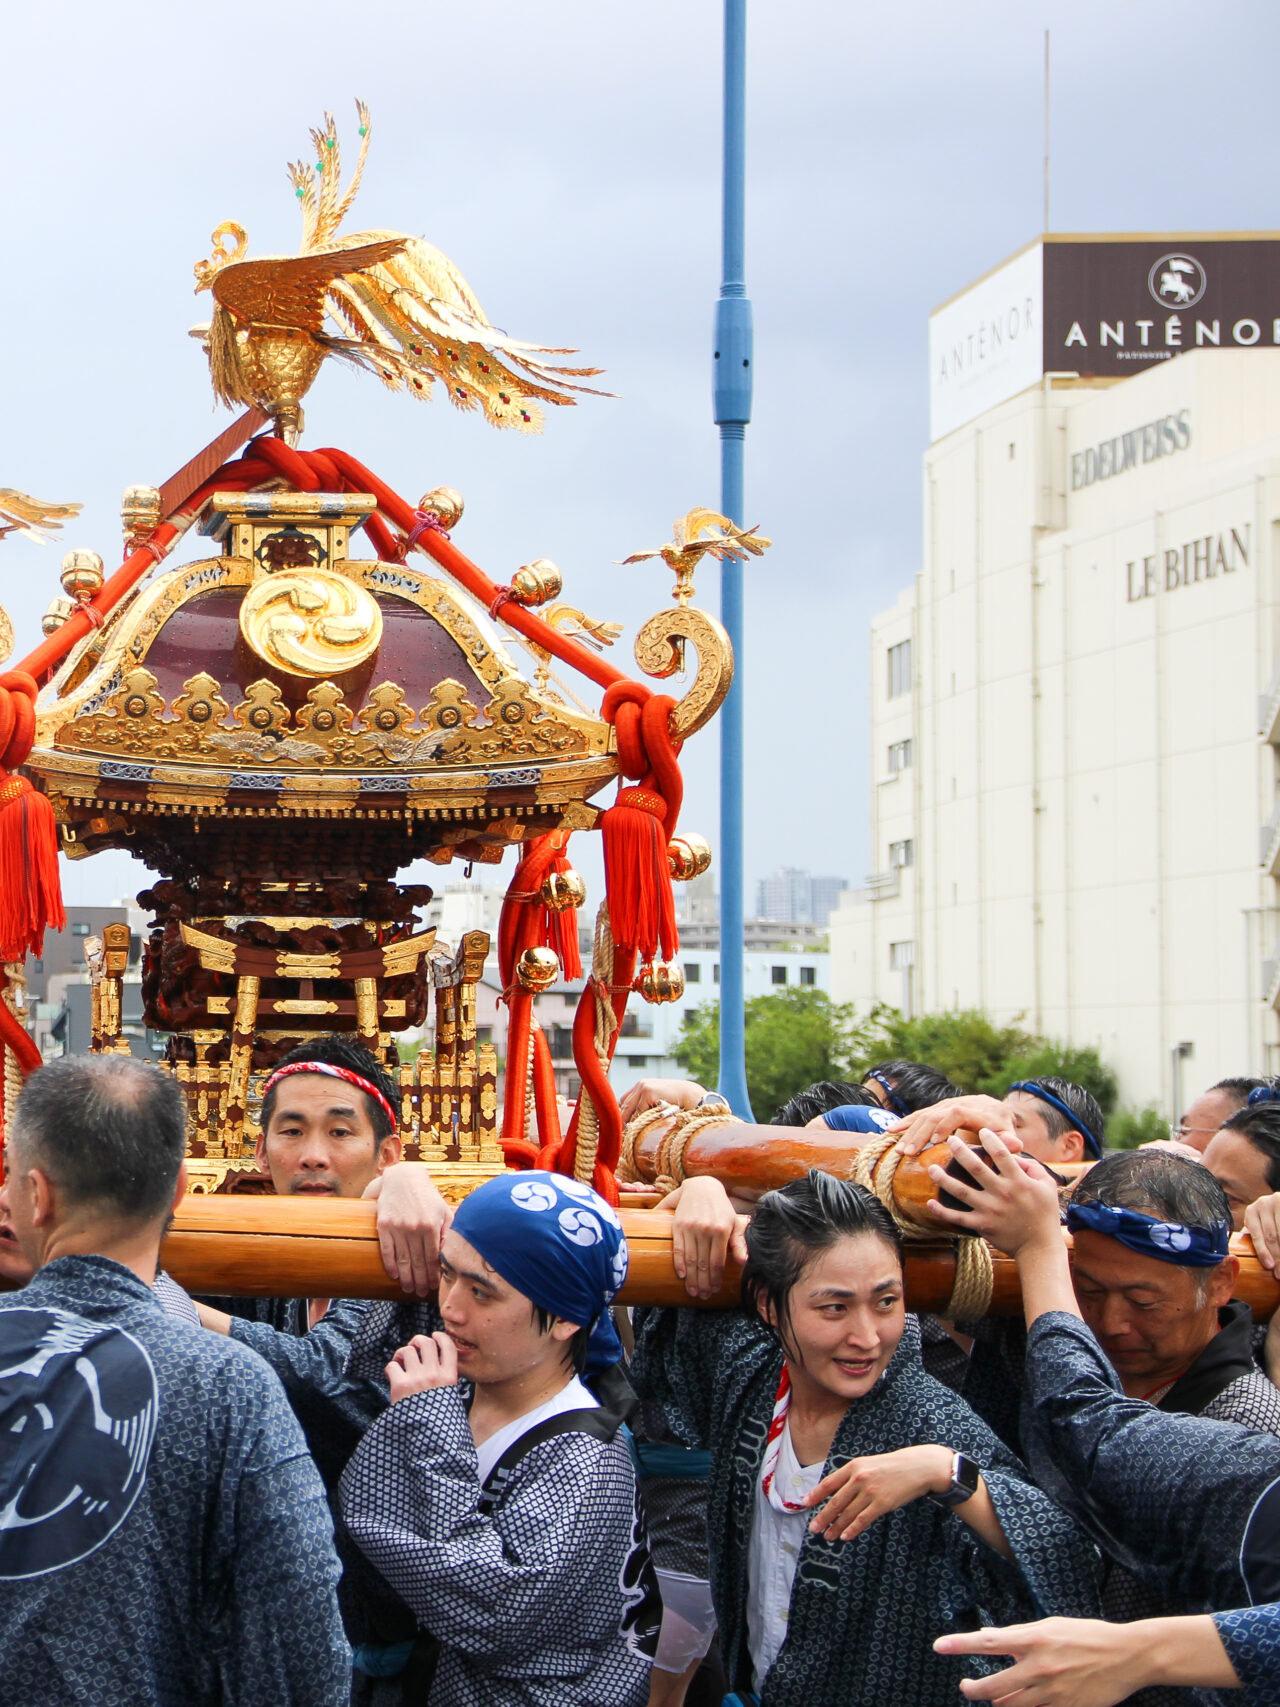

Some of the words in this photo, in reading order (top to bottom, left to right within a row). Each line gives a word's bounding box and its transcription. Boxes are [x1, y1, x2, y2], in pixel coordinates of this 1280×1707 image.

[1071, 409, 1191, 492] EDELWEISS
[1127, 555, 1156, 603] LE
[1164, 524, 1252, 593] BIHAN
